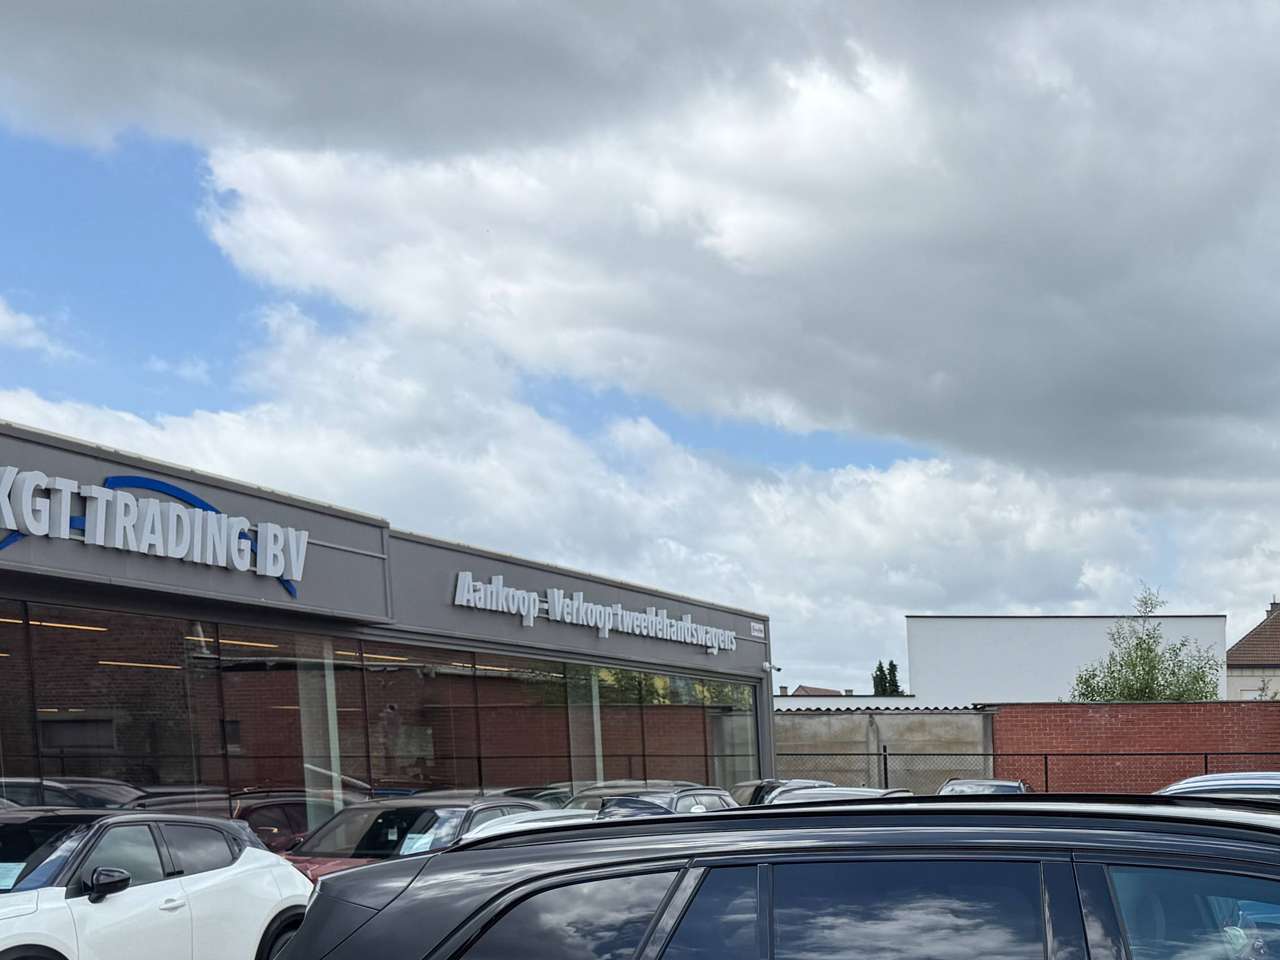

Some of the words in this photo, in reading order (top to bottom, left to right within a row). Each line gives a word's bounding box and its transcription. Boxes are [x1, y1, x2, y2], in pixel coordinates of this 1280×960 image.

[80, 484, 251, 572] TRADING
[256, 522, 309, 582] BV
[454, 571, 539, 627] Aankoop
[547, 588, 613, 638] Verkoop
[613, 603, 737, 655] tweedehandswagens
